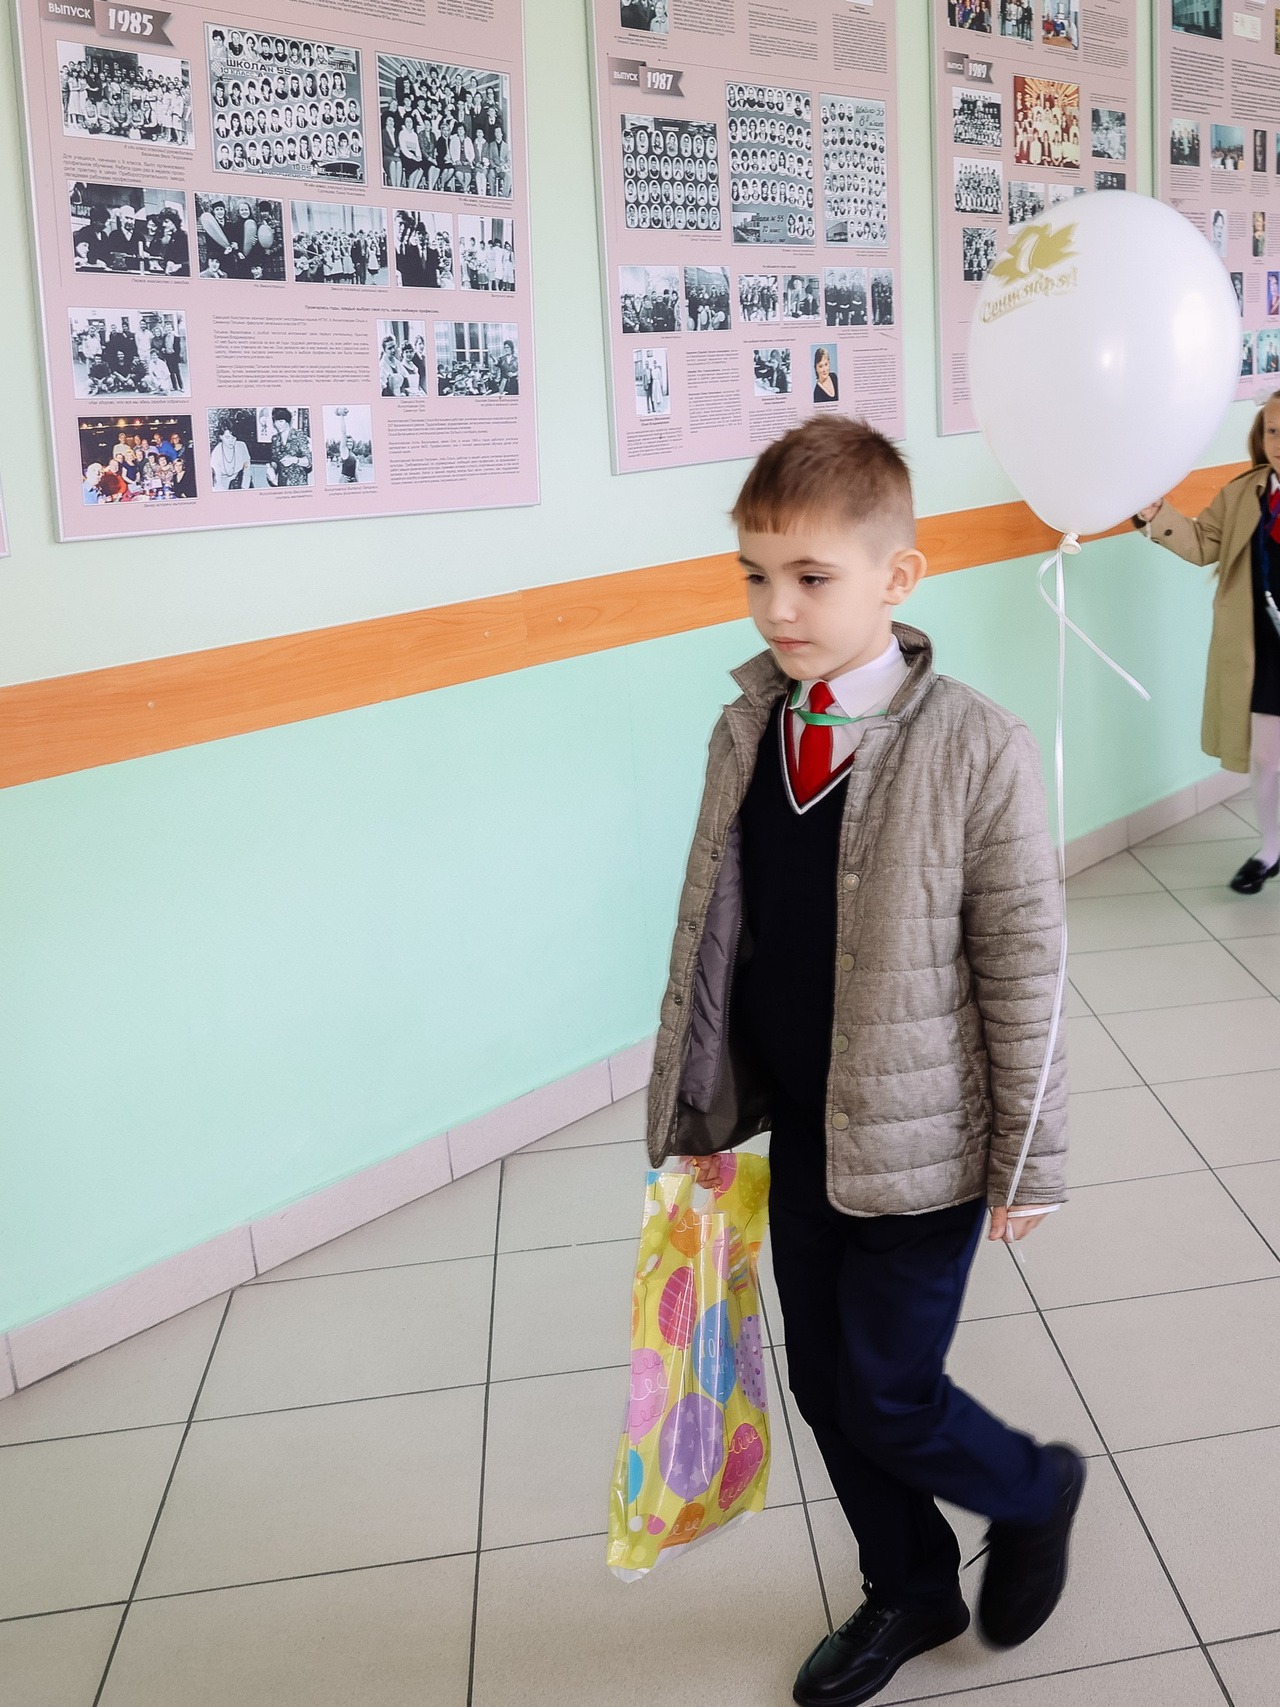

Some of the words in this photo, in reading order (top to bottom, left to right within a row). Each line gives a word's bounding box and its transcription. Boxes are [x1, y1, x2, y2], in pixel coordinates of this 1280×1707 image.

[48, 2, 92, 19] ВЫПУСК
[108, 8, 154, 36] 1985
[226, 59, 267, 72] ШКОЛА
[276, 66, 292, 75] 55
[613, 71, 639, 81] ВЫПУСК
[646, 71, 674, 91] 1987
